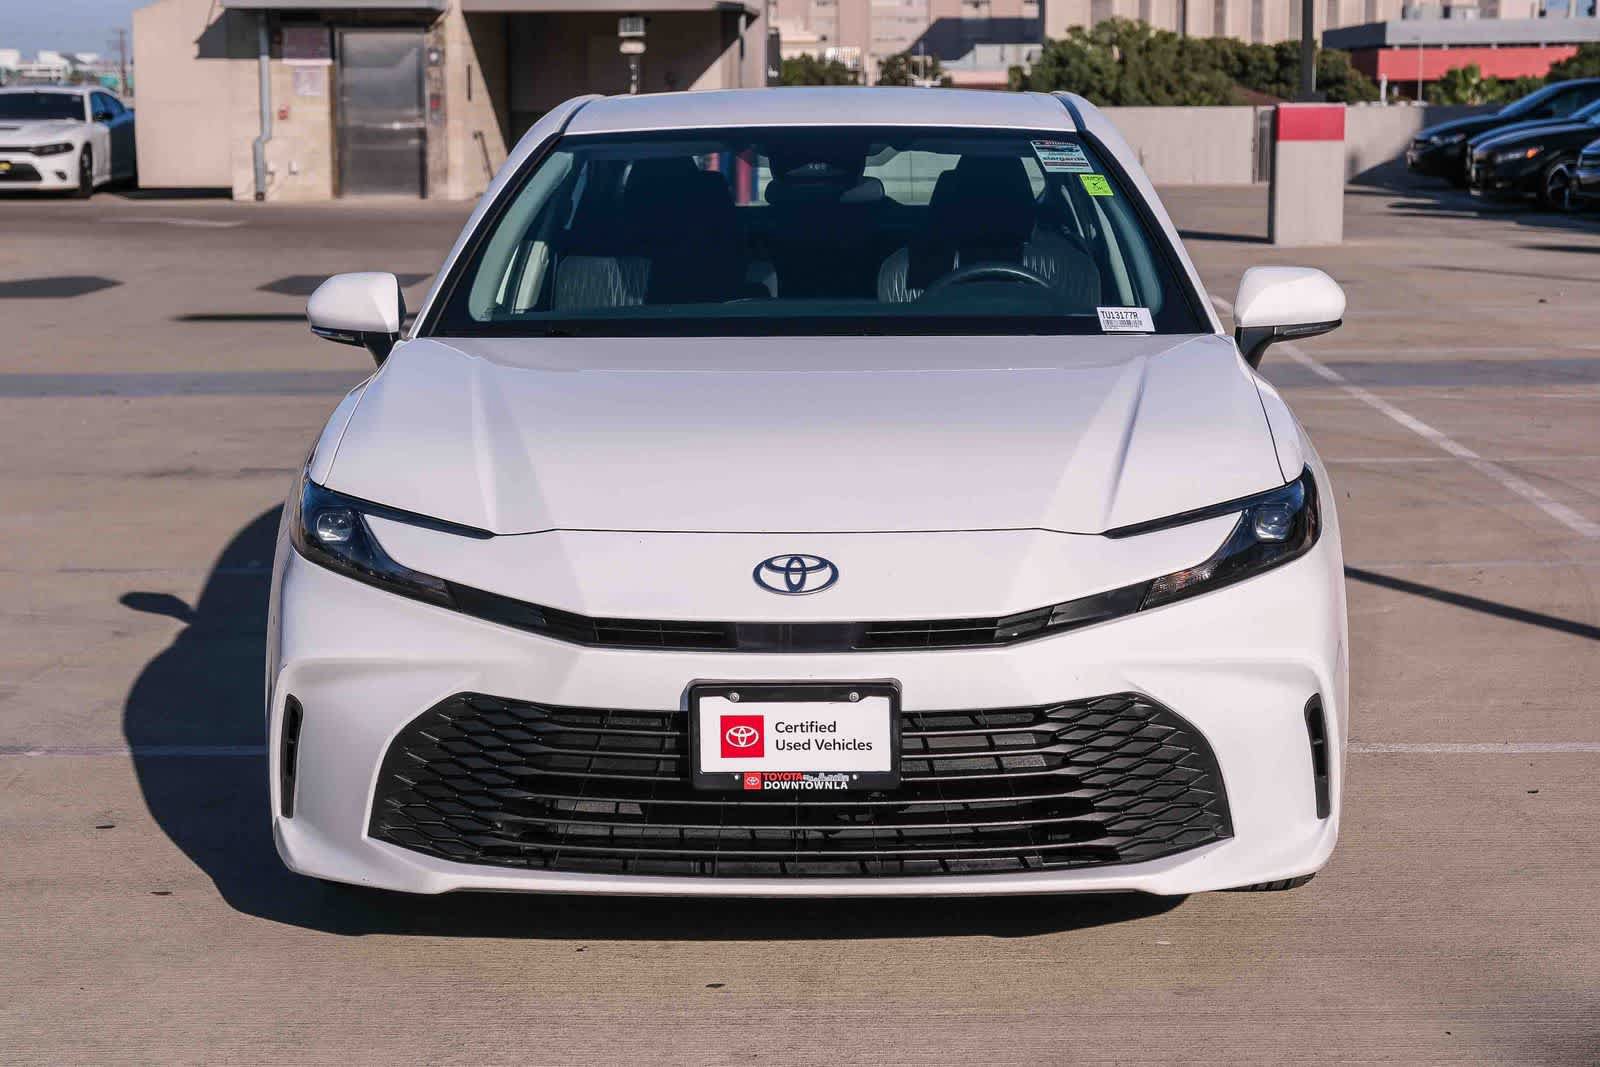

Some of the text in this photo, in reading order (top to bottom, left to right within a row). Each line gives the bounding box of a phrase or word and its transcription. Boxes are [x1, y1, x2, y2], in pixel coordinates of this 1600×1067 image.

[774, 721, 837, 733] Certified
[775, 738, 873, 751] Used Vehicles
[763, 772, 804, 781] TOYOTA
